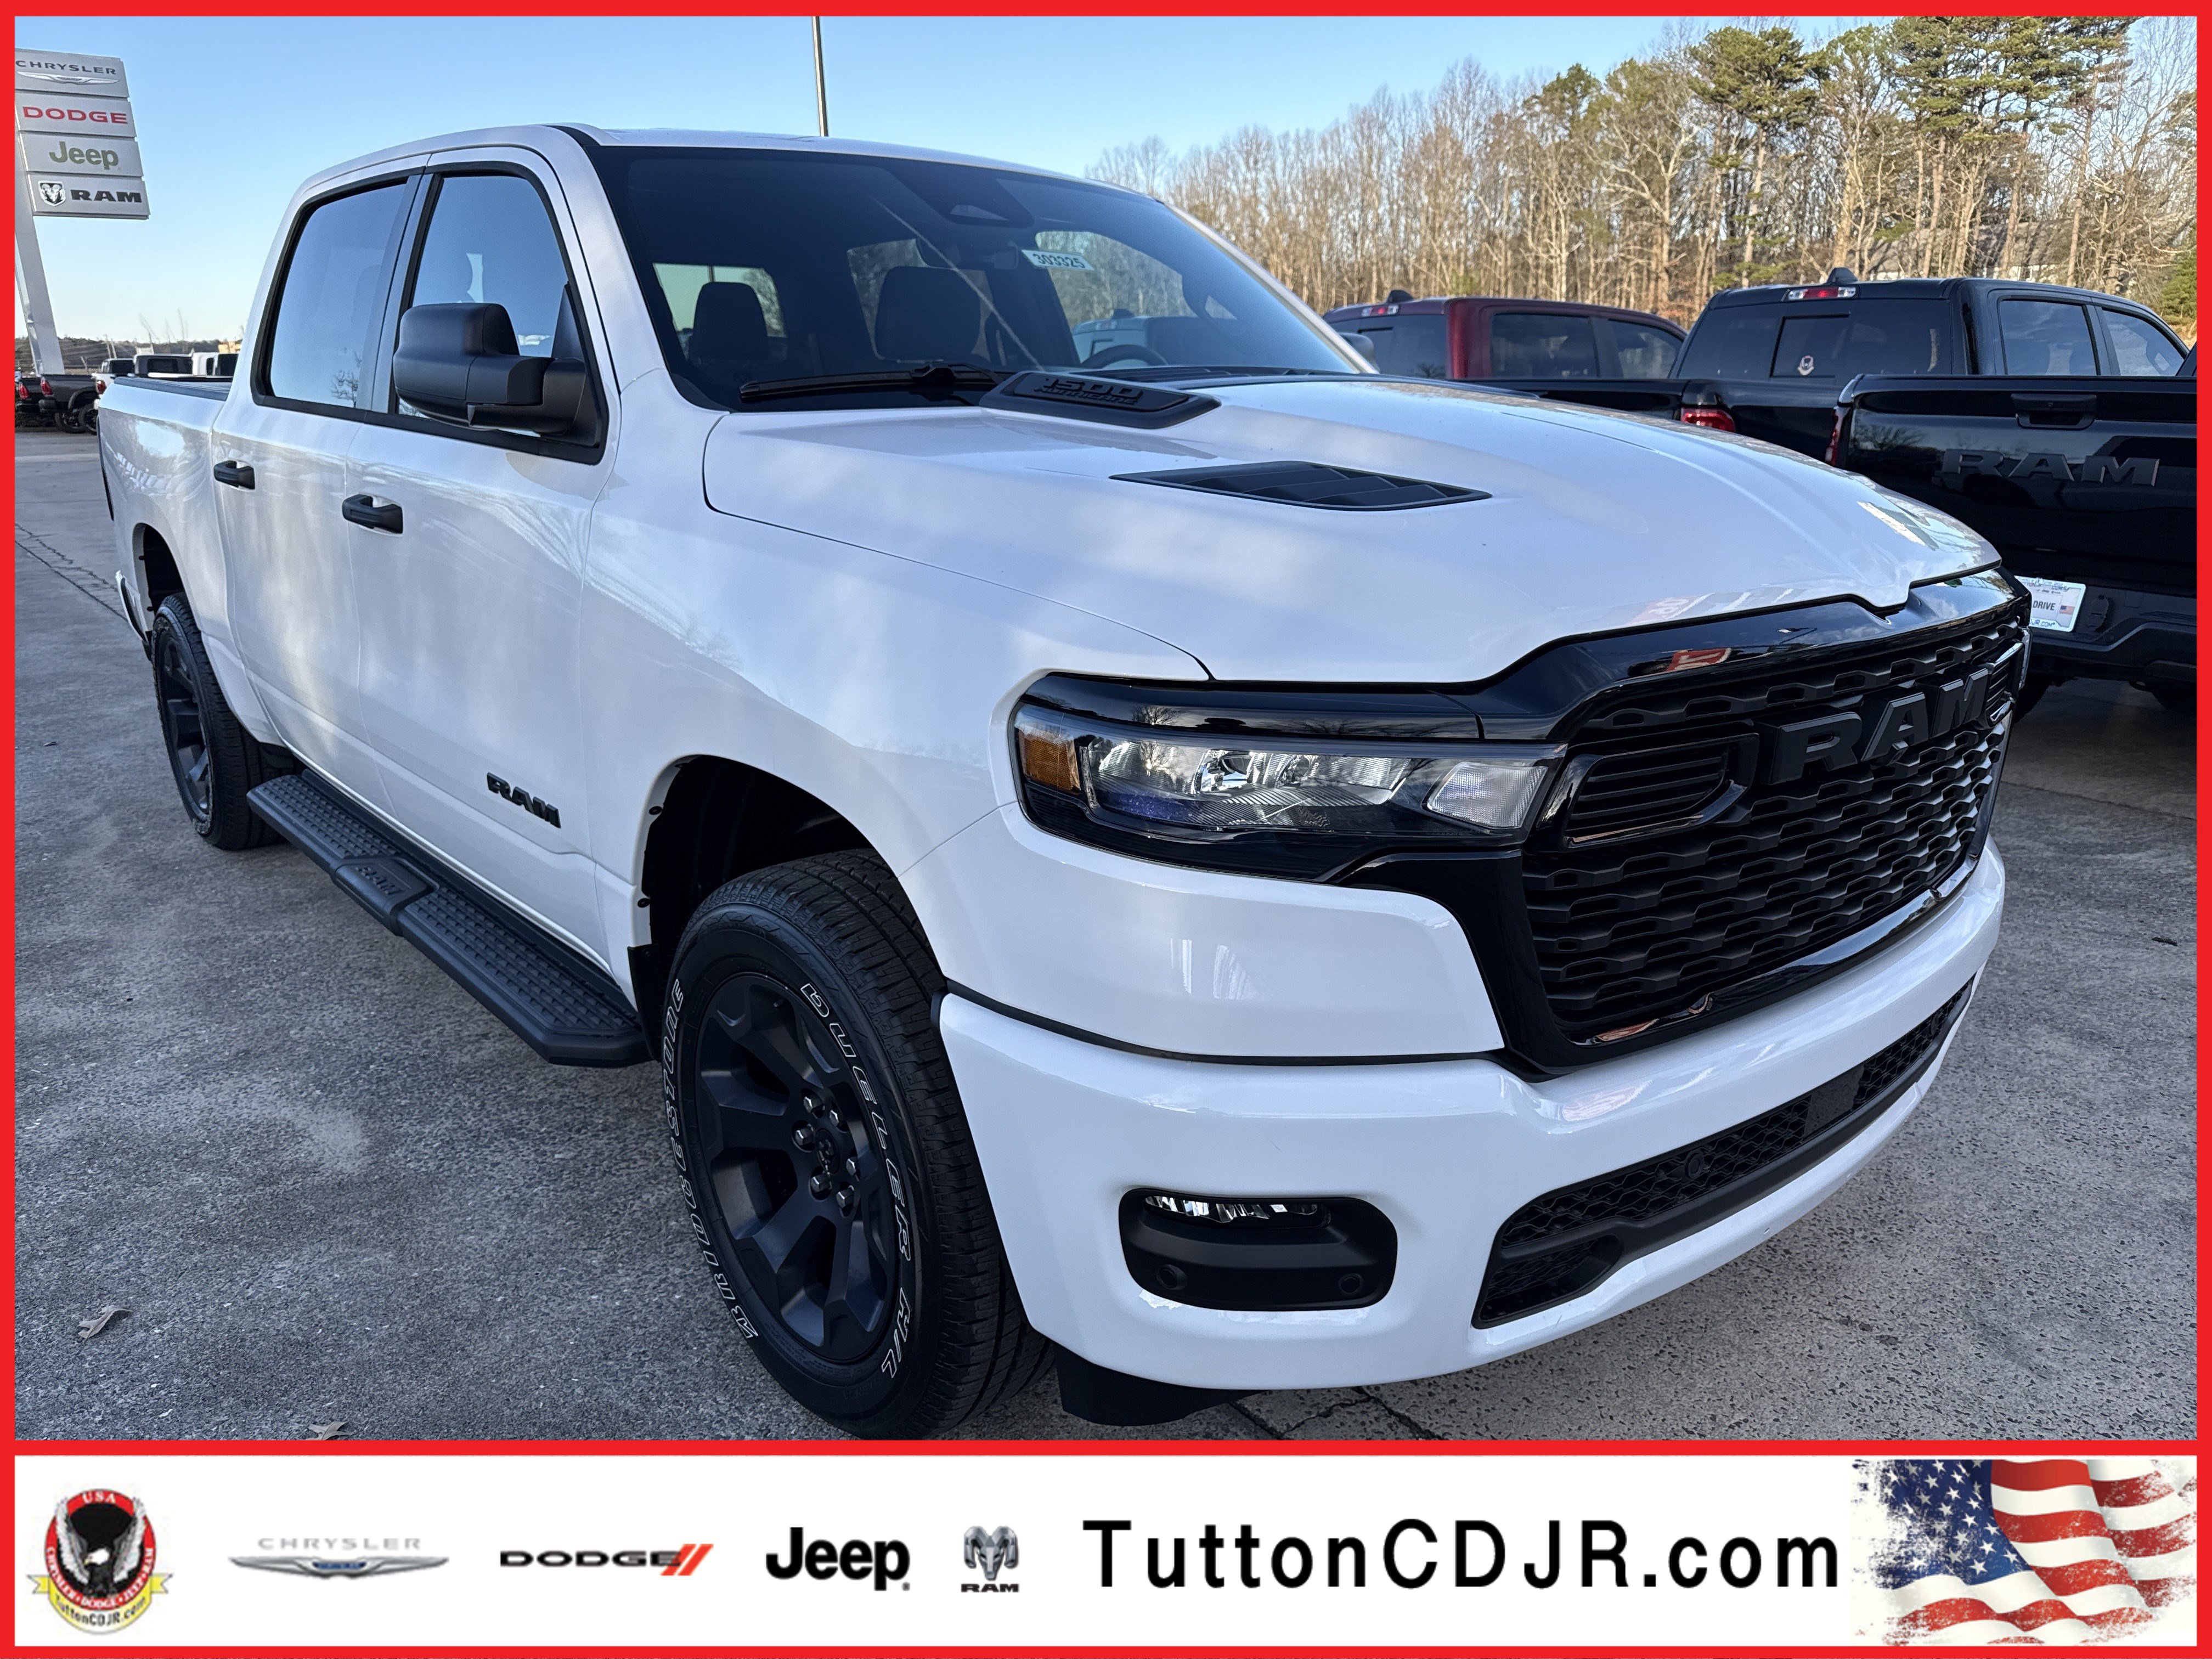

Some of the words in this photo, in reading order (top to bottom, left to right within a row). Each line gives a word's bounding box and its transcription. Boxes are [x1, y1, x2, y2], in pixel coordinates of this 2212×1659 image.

[15, 60, 116, 75] CHRYSLER
[22, 106, 128, 124] DODGE
[49, 141, 119, 170] Jeep
[71, 189, 142, 203] RAM
[1032, 253, 1086, 268] 303325
[1043, 378, 1143, 400] 1500
[1942, 449, 2160, 487] RAM
[2032, 600, 2056, 611] DRIVE
[1767, 668, 1989, 786] RAM
[487, 772, 561, 829] RAM
[800, 983, 911, 1262] DUELER
[662, 979, 758, 1340] BRIDGESTONE
